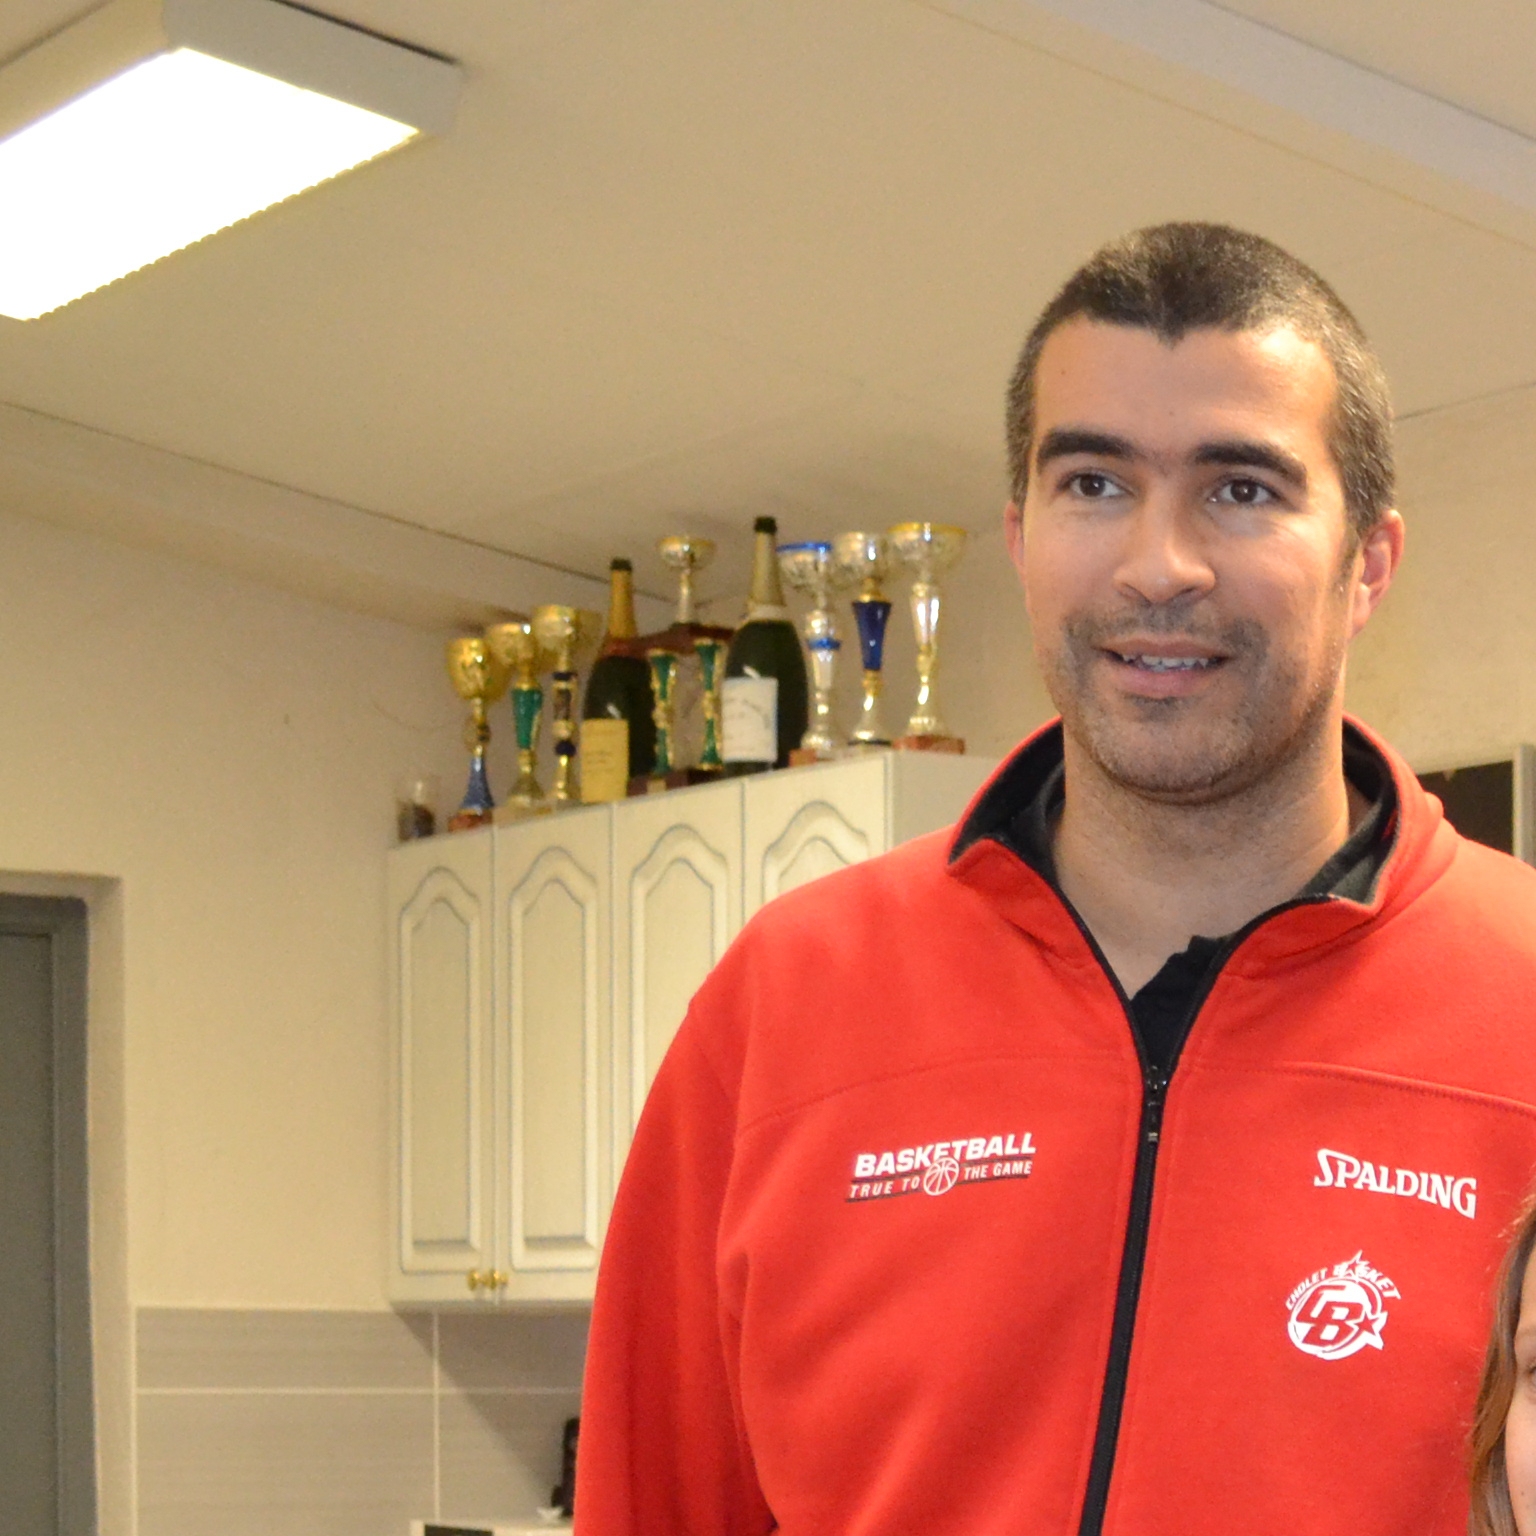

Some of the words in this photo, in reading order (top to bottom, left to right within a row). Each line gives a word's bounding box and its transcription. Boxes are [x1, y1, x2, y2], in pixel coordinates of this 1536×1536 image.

[854, 1131, 1037, 1178] BASKETBALL
[849, 1179, 893, 1199] TRUE
[902, 1175, 921, 1192] TO
[963, 1162, 989, 1181] THE
[993, 1159, 1033, 1178] GAME
[1313, 1148, 1477, 1219] SPALDING
